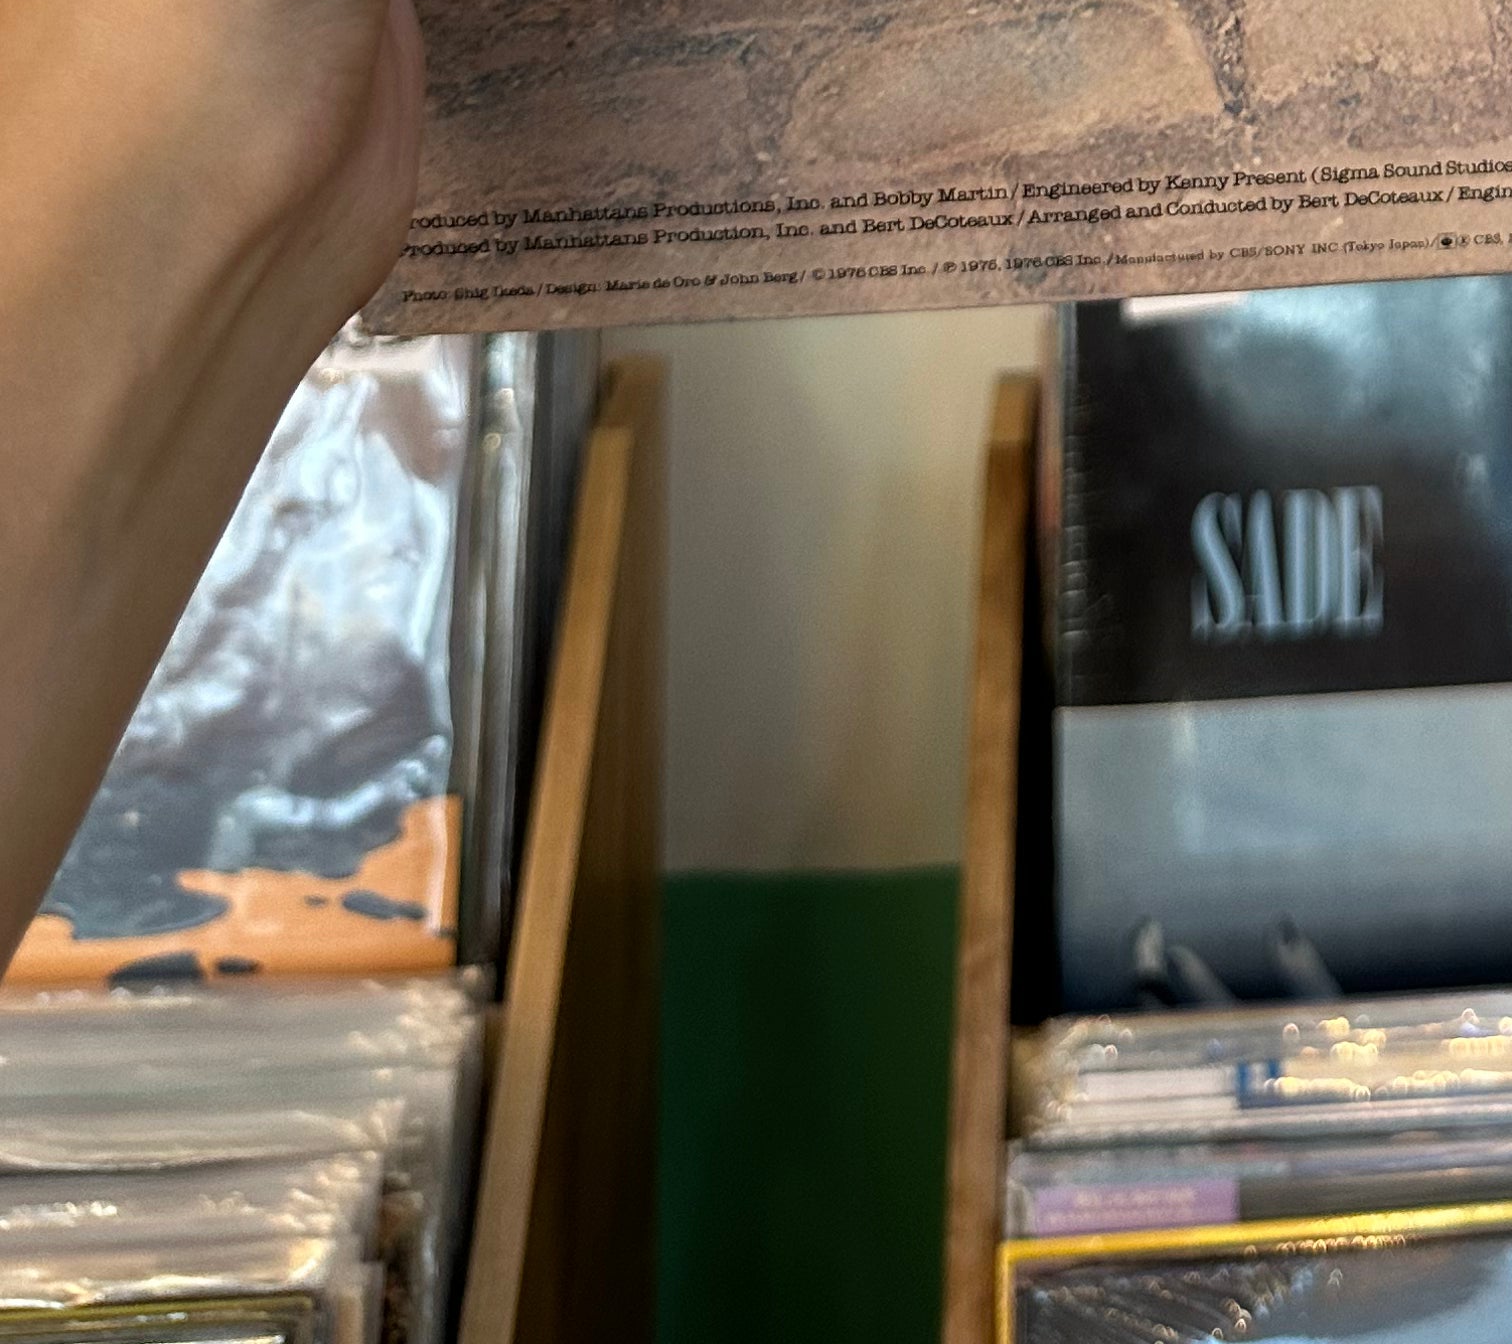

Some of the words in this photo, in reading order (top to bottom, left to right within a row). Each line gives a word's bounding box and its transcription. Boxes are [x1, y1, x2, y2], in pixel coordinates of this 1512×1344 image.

[410, 212, 489, 229] roduced
[492, 211, 518, 229] by
[523, 207, 648, 224] Manhattans
[653, 199, 783, 218] Productions,
[830, 193, 868, 210] and
[872, 190, 933, 208] Bobby
[937, 187, 1008, 203] Martin
[1022, 178, 1133, 199] Engineered
[1137, 178, 1161, 195] by
[1165, 175, 1229, 192] Kenny
[1233, 169, 1307, 186] Present
[1311, 167, 1380, 185] (Sigma
[1384, 161, 1443, 179] Sound
[495, 239, 519, 256] by
[524, 234, 648, 251] Manhattans
[653, 227, 770, 245] Production,
[819, 220, 857, 238] and
[862, 219, 905, 234] Bert
[908, 214, 1014, 231] DeCoteaux
[1026, 206, 1121, 225] Arranged
[1126, 203, 1163, 220] and
[1165, 197, 1268, 216] Conducted
[1270, 197, 1294, 214] by
[1298, 194, 1339, 212] Bert
[1344, 191, 1446, 208] DeCoteaux
[1191, 485, 1384, 644] SADE
